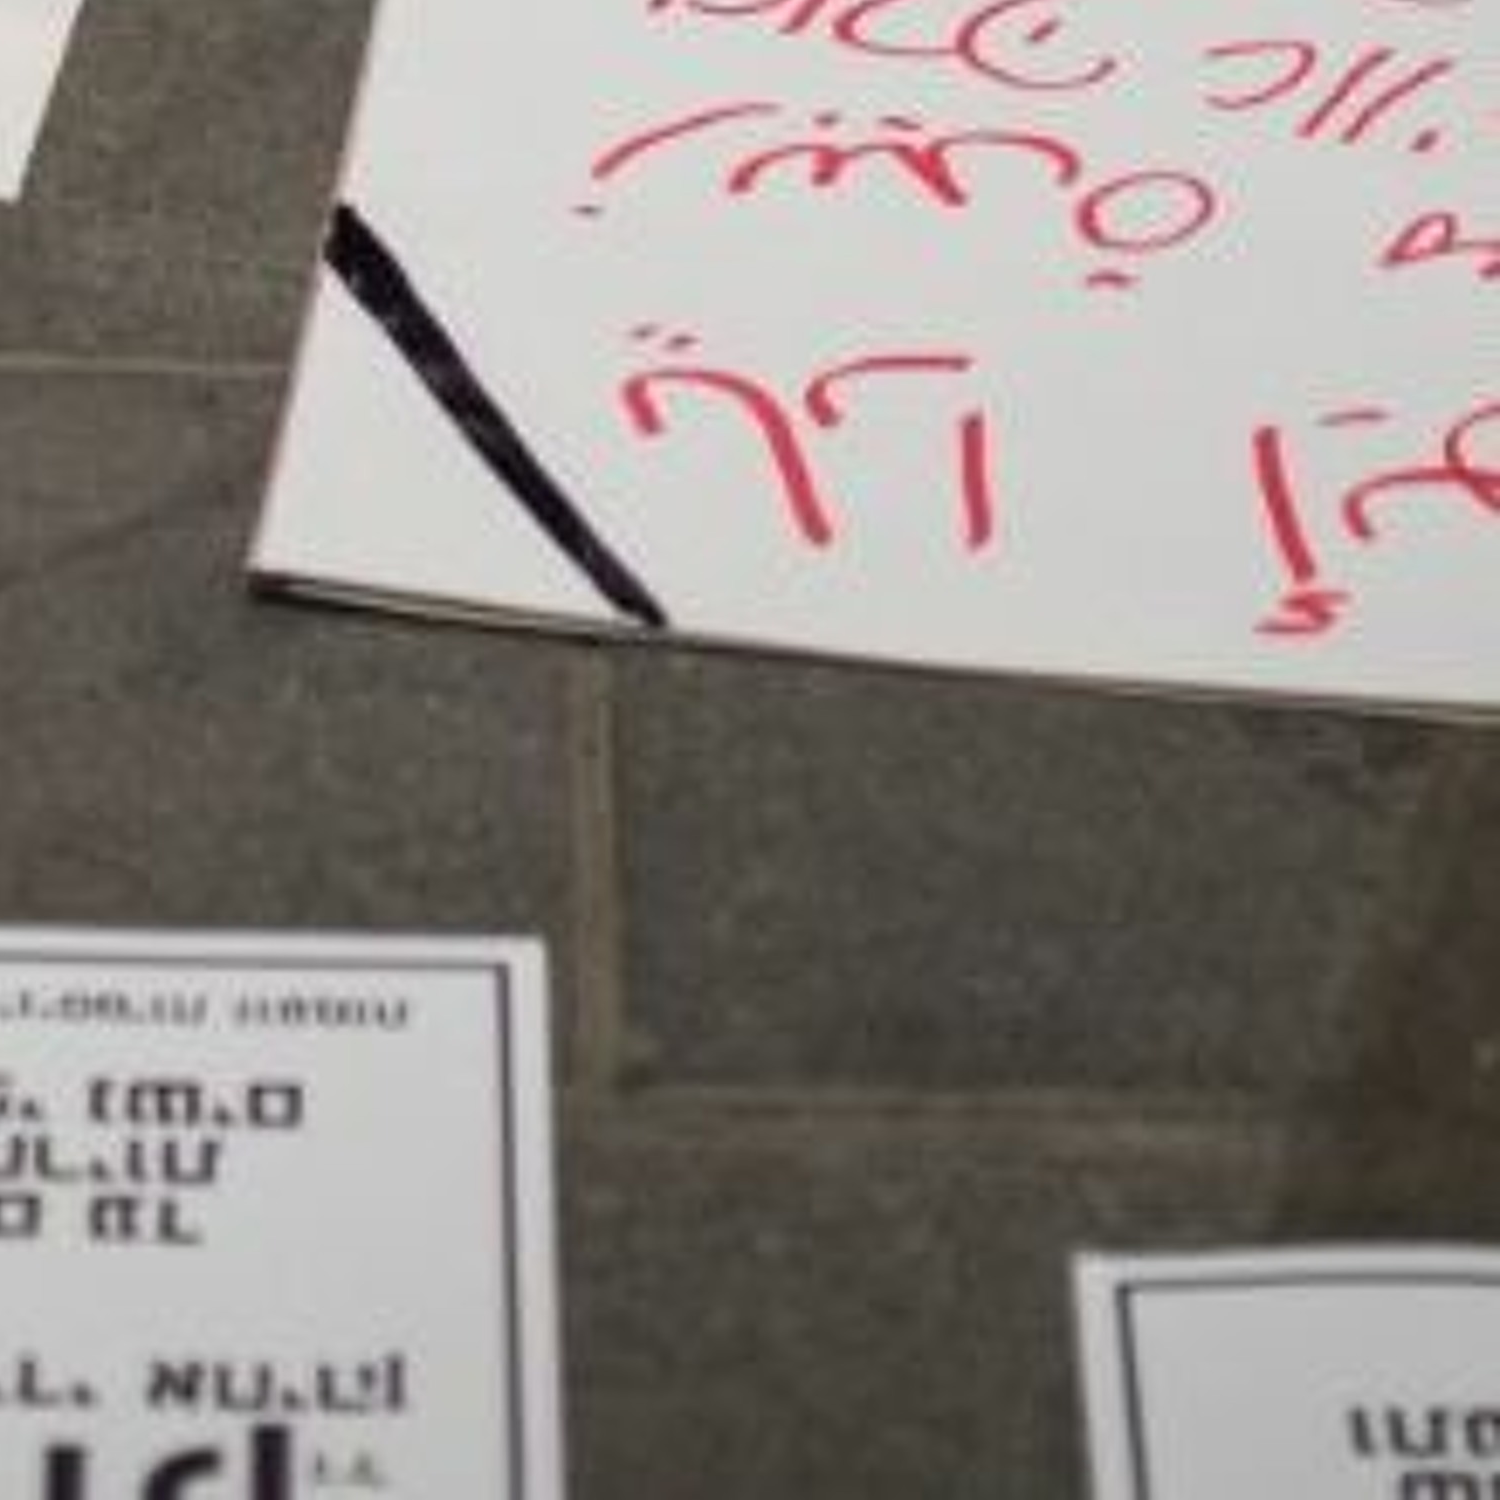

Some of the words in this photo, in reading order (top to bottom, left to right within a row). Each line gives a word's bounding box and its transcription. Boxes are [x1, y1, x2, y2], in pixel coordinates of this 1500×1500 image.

[86, 1077, 307, 1132] נשים
[87, 1193, 203, 1246] עד
[145, 1352, 409, 1417] אחיהן
